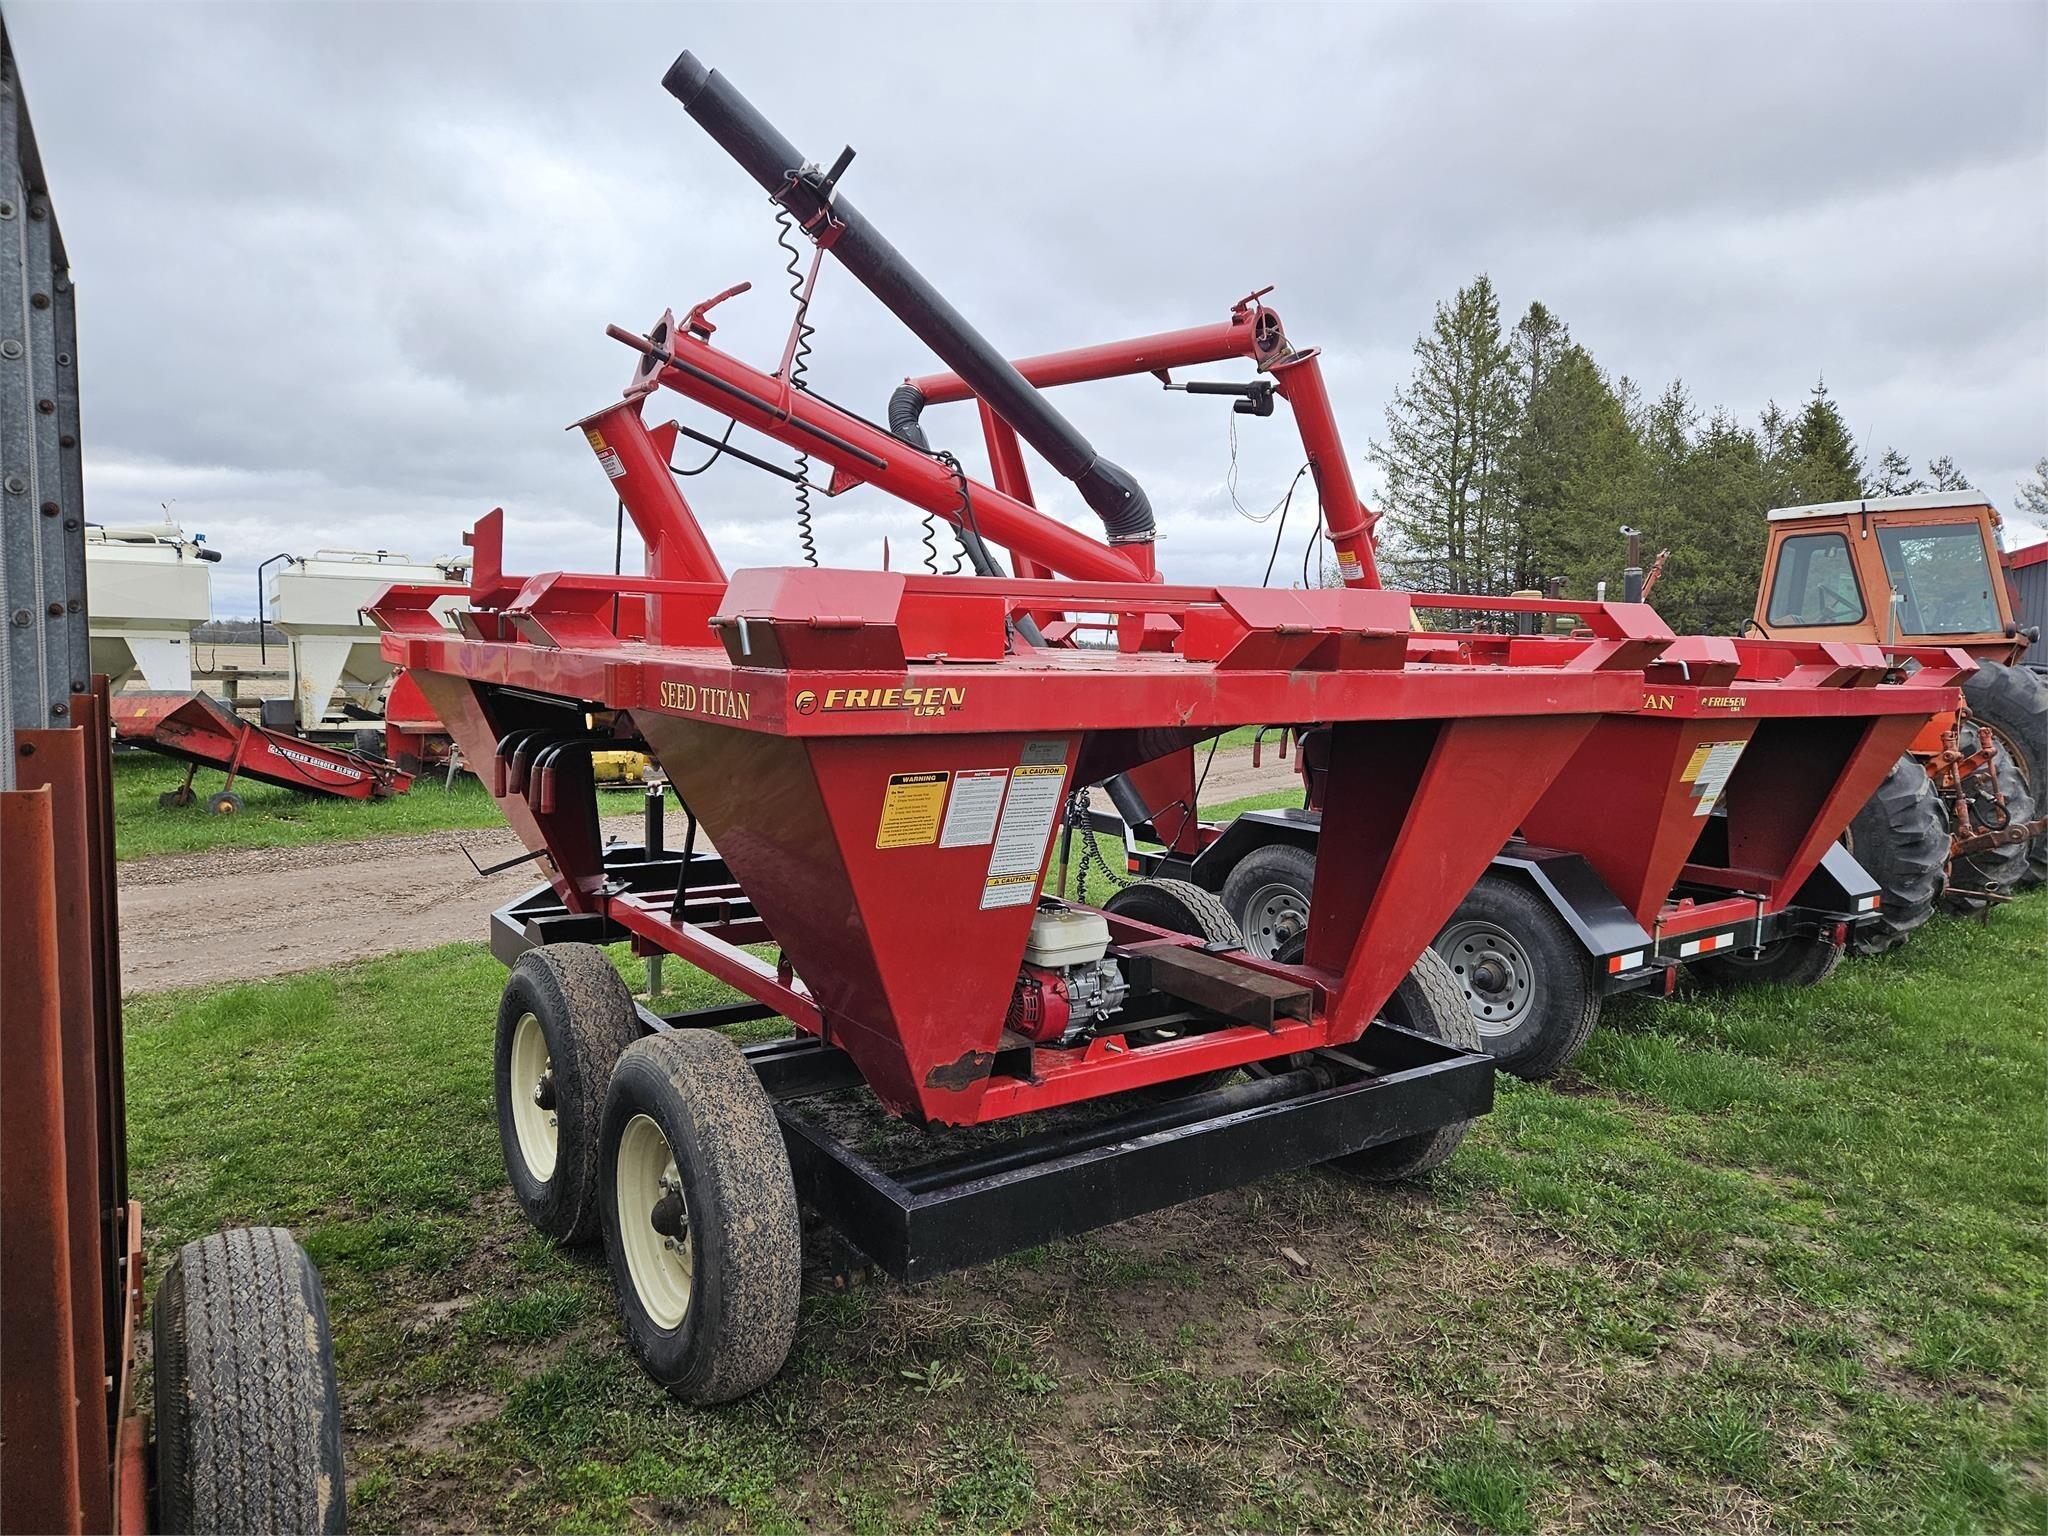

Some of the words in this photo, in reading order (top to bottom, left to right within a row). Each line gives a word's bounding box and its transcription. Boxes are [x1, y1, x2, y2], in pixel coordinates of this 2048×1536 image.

[660, 681, 696, 711] SEED
[700, 686, 751, 721] TITAN
[823, 687, 966, 708] FRIESEN
[1708, 697, 1747, 707] FRIESEN
[913, 706, 946, 717] USA
[902, 775, 937, 783] WARNING
[1001, 876, 1031, 884] CAUTION
